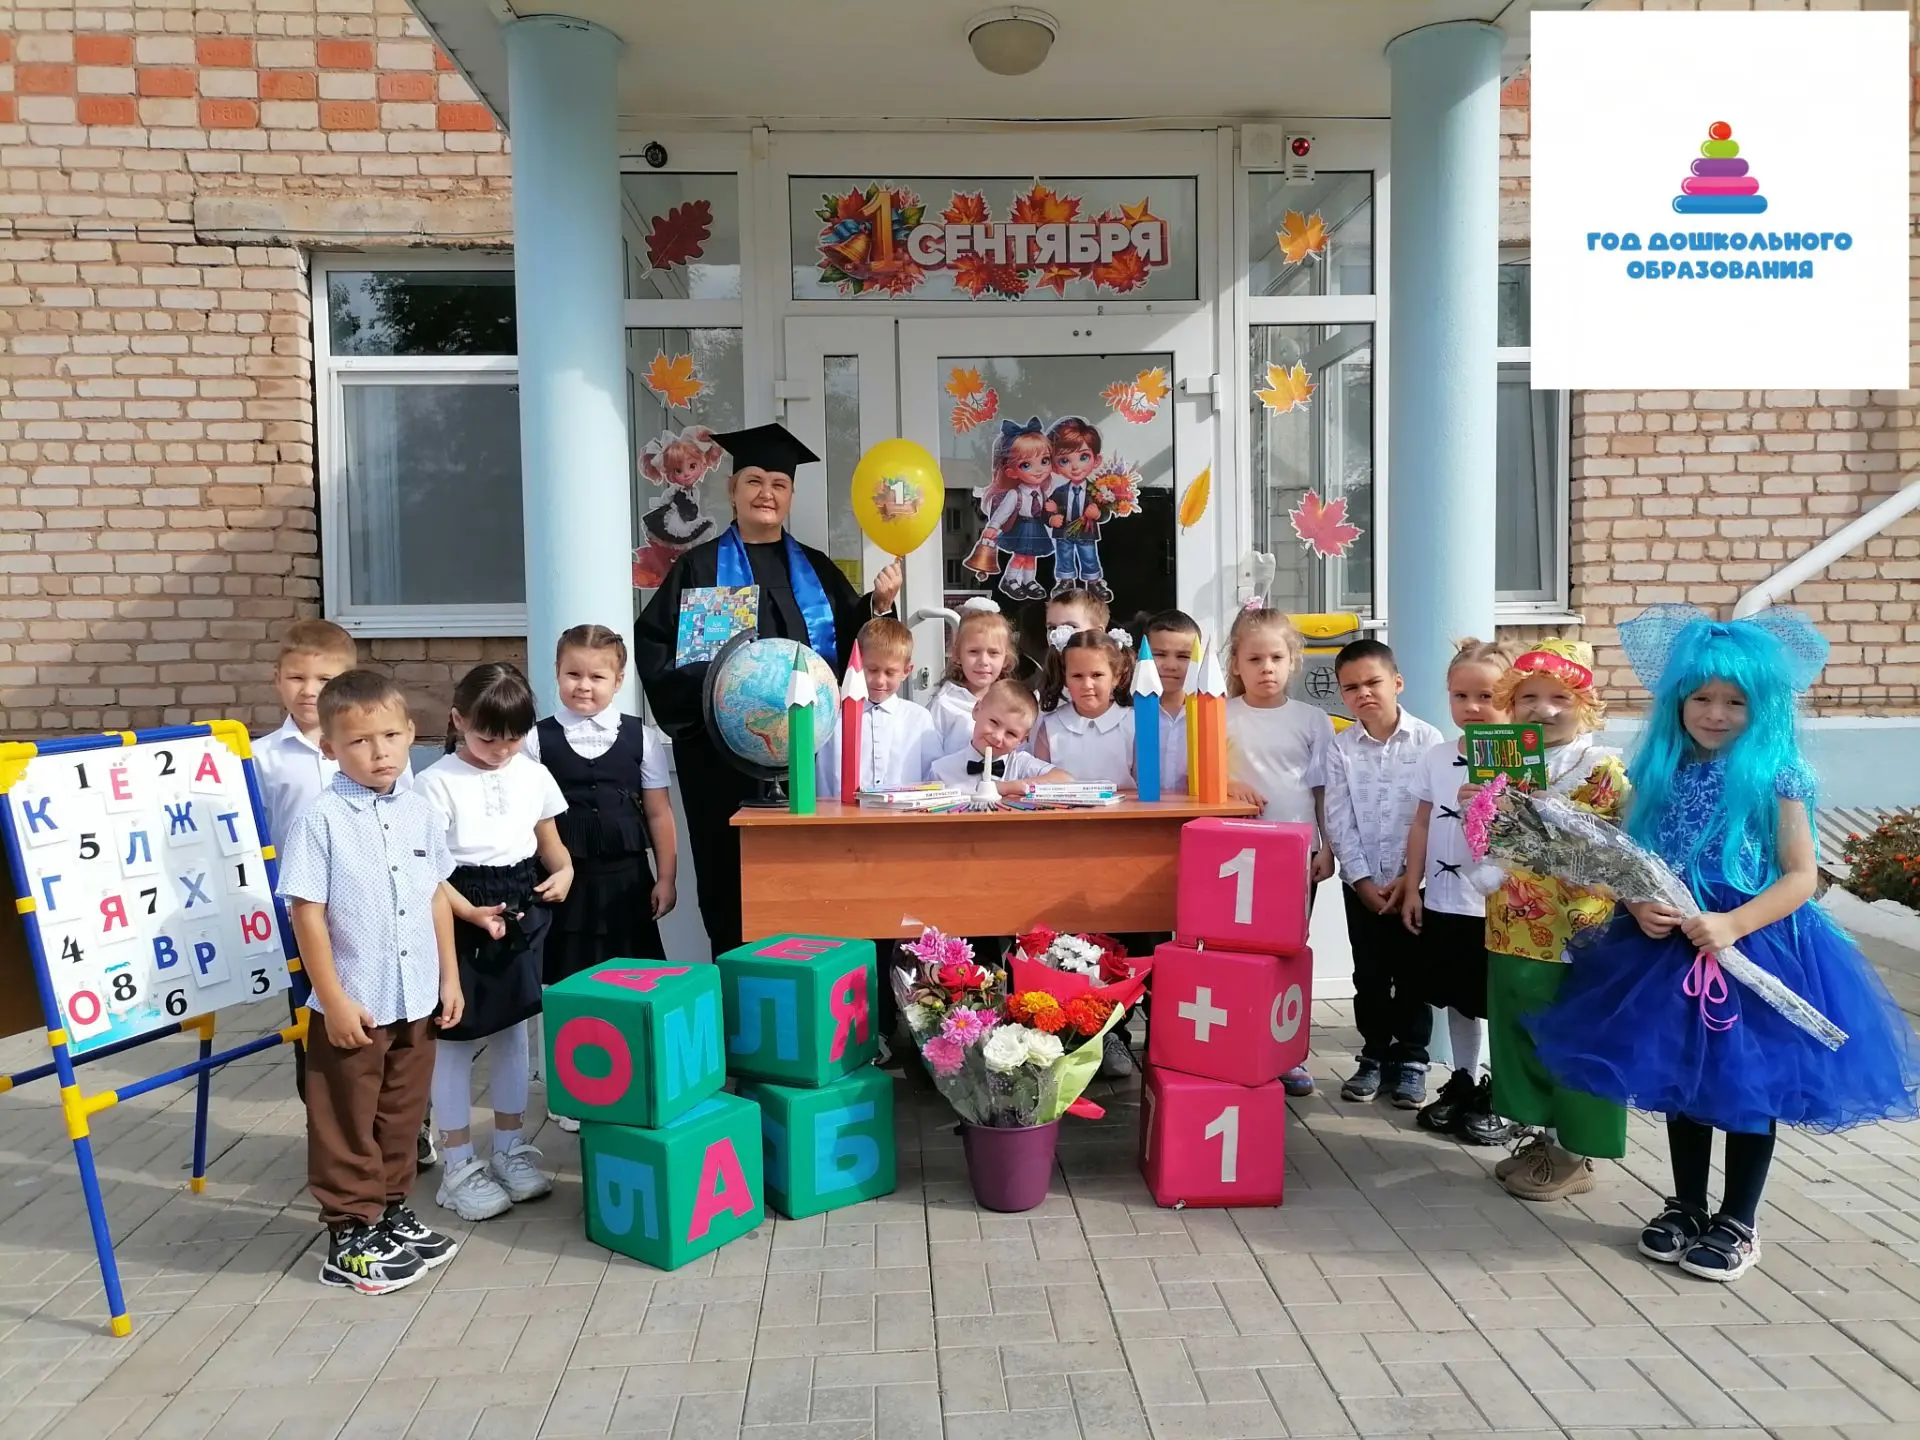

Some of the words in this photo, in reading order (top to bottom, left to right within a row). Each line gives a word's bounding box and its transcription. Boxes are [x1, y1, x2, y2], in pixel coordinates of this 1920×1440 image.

[862, 190, 897, 272] 1
[907, 221, 1163, 266] СЕНТЯБРЯ
[891, 481, 904, 504] 1
[154, 750, 176, 776] 2
[194, 753, 222, 784] А
[1472, 739, 1522, 768] БУКВАРЬ
[74, 762, 91, 789] 1
[110, 761, 133, 800] Ё
[22, 796, 58, 834] К
[164, 801, 198, 836] Ж
[217, 812, 239, 843] Т
[79, 832, 100, 859] 5
[126, 831, 152, 864] Л
[180, 872, 212, 908] Х
[235, 863, 248, 887] 1
[1219, 848, 1256, 924] 1
[41, 874, 61, 911] Г
[140, 887, 158, 914] 7
[100, 895, 129, 932] Я
[240, 910, 272, 944] Ю
[61, 935, 85, 963] 4
[152, 936, 178, 970] В
[194, 941, 216, 974] Р
[753, 938, 847, 960] Е
[112, 973, 137, 1001] 8
[251, 968, 271, 994] 3
[589, 966, 692, 993] А
[68, 990, 101, 1025] О
[165, 989, 188, 1016] 6
[730, 976, 798, 1061] Л
[829, 964, 868, 1063] Я
[554, 1016, 632, 1106] О
[664, 990, 719, 1101] М
[815, 1101, 879, 1195] Б
[1204, 1106, 1240, 1183] 1
[687, 1137, 754, 1243] А
